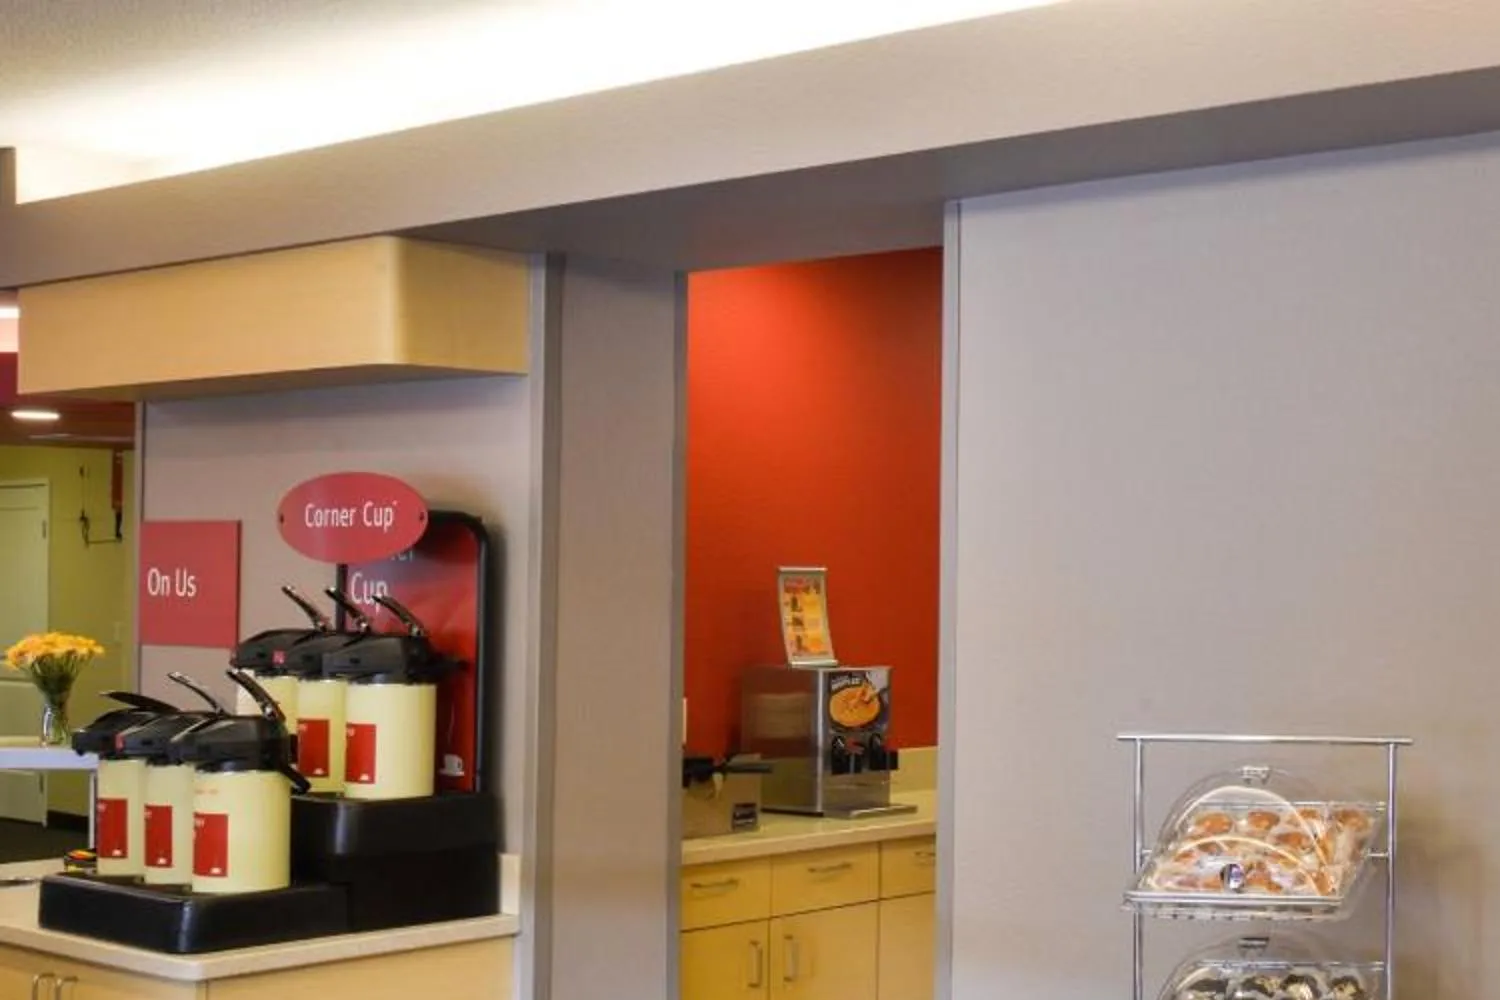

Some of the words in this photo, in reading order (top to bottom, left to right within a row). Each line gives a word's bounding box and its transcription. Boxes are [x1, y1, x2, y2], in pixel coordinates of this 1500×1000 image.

[304, 503, 357, 528] Corner
[362, 500, 395, 532] Cup
[147, 567, 171, 596] On
[175, 568, 197, 597] Us
[350, 571, 389, 613] Cup
